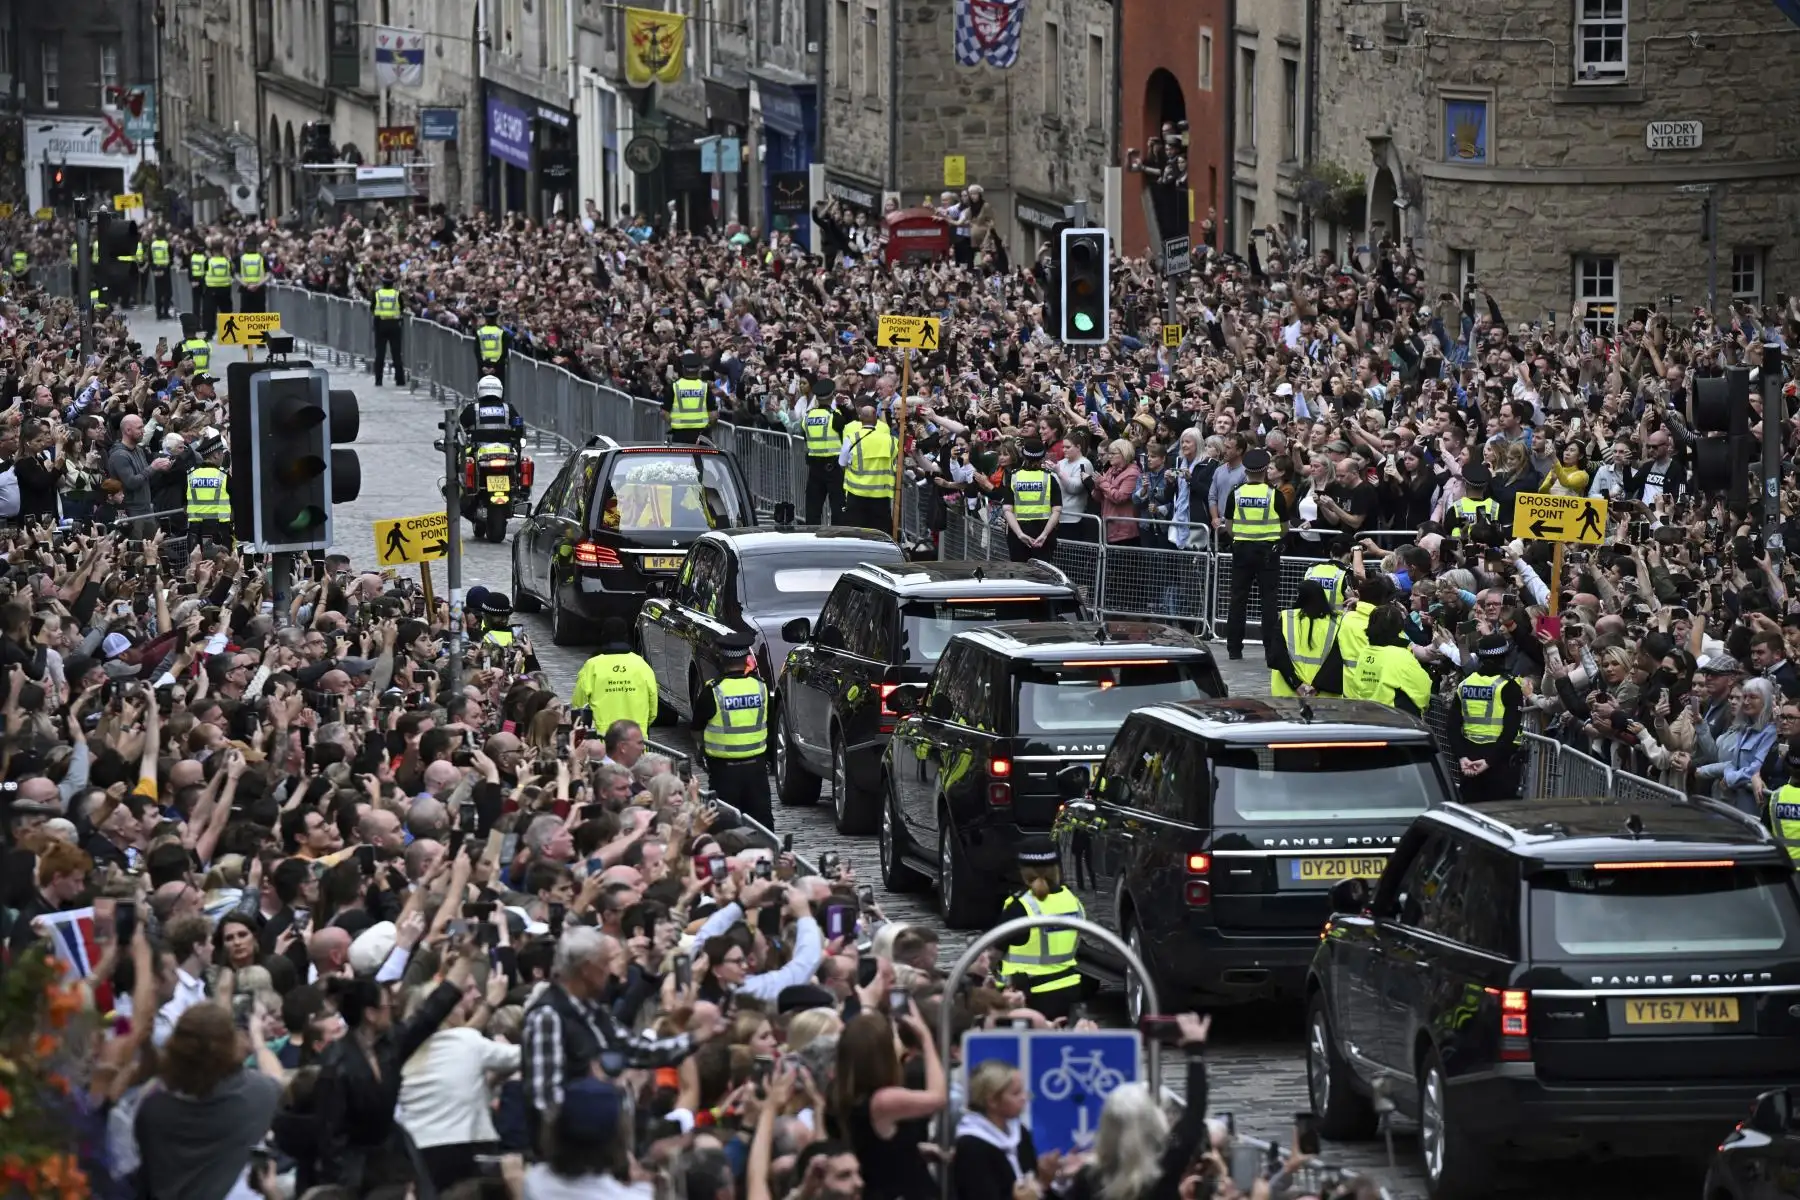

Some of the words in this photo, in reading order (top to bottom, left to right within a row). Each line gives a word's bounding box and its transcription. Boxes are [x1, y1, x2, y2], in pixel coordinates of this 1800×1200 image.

[1652, 123, 1697, 135] NIDDRY
[1652, 135, 1697, 147] STREET
[881, 317, 920, 326] CROSSING
[680, 389, 702, 397] POLICE
[807, 418, 827, 426] POLICE
[192, 478, 219, 487] POLICE
[1018, 482, 1042, 491] POLICE
[1240, 498, 1266, 506] POLICE
[1519, 495, 1579, 509] CROSSING
[1530, 508, 1565, 520] POINT
[407, 515, 448, 530] CROSSIN
[420, 528, 448, 540] POINT
[652, 557, 666, 567] WP
[669, 557, 683, 568] 45
[1463, 686, 1492, 699] POLICE
[725, 695, 760, 709] POLICE
[1057, 744, 1106, 752] RANG
[1777, 805, 1800, 818] POL
[1263, 837, 1334, 846] RANGE
[1347, 836, 1401, 845] ROVE
[1303, 860, 1346, 876] OY20
[1351, 859, 1384, 875] URD
[1591, 975, 1674, 984] RANGE
[1690, 972, 1772, 983] ROVER
[1633, 1002, 1685, 1020] YT67
[1691, 1001, 1730, 1019] YMA
